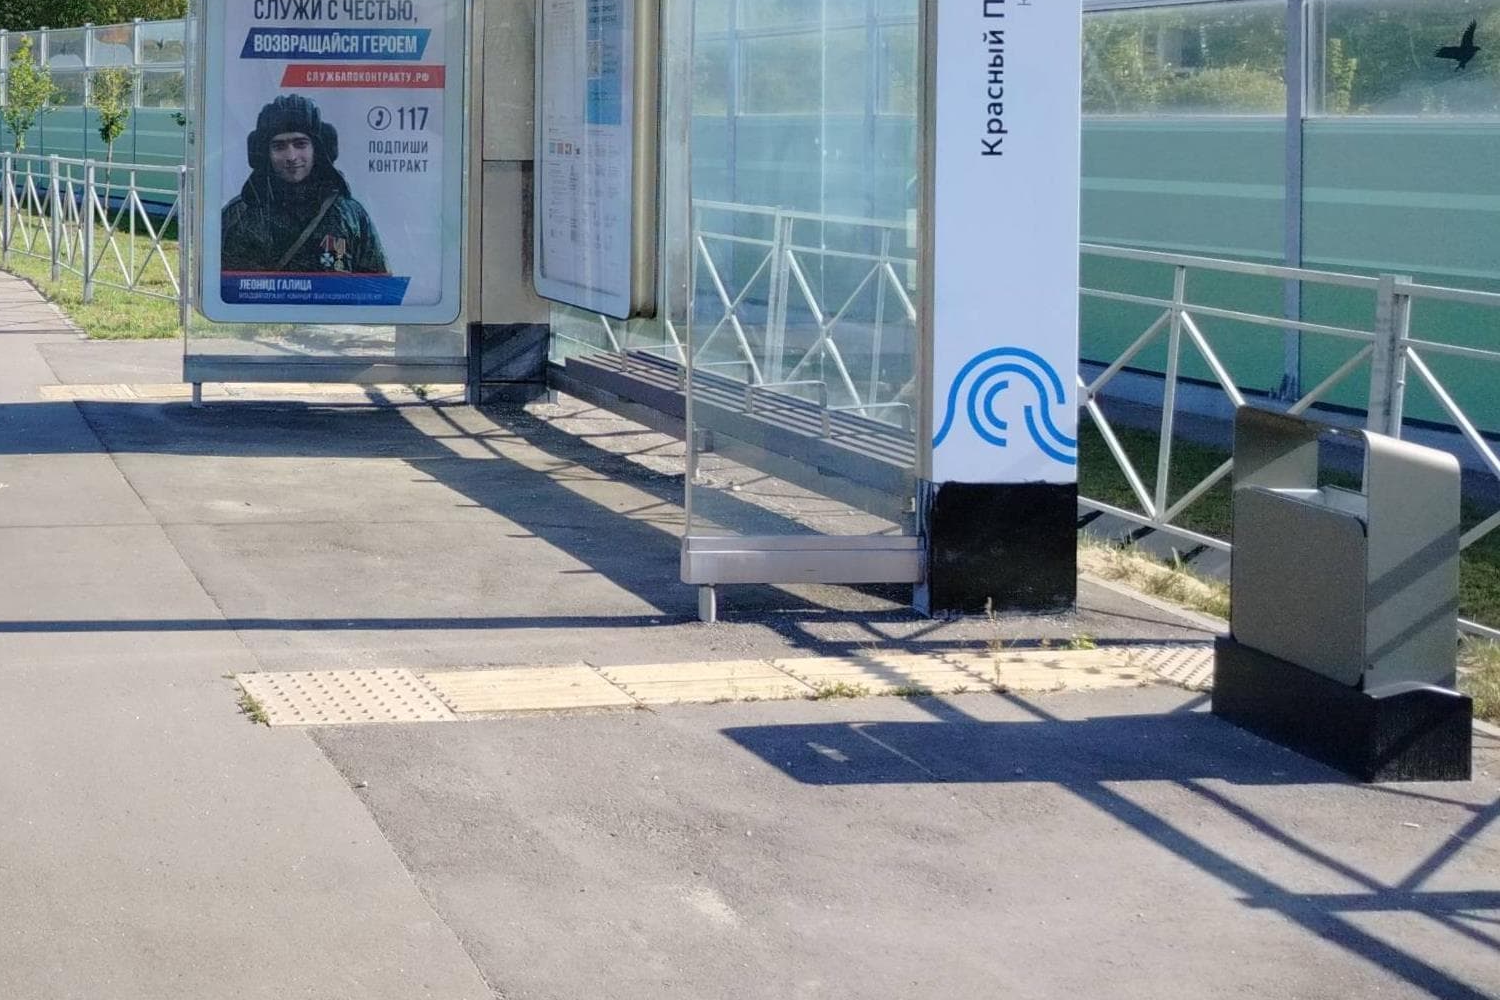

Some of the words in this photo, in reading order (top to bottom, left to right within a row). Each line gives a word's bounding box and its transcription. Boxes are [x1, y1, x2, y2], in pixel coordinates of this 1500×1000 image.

[254, 0, 322, 20] СЛУЖИ
[328, 0, 339, 20] С
[343, 0, 418, 24] ЧЕСТЬЮ,
[254, 32, 359, 54] ВОЗВРАЩАЙСЯ
[362, 35, 417, 53] ГЕРОЕМ
[306, 71, 430, 83] СЛУЖБАПОКОНТРАКТУ.РФ
[981, 30, 1007, 156] Красный
[397, 106, 429, 131] 117
[368, 140, 428, 155] ПОДПИШИ
[368, 158, 428, 173] КОНТРАКТ
